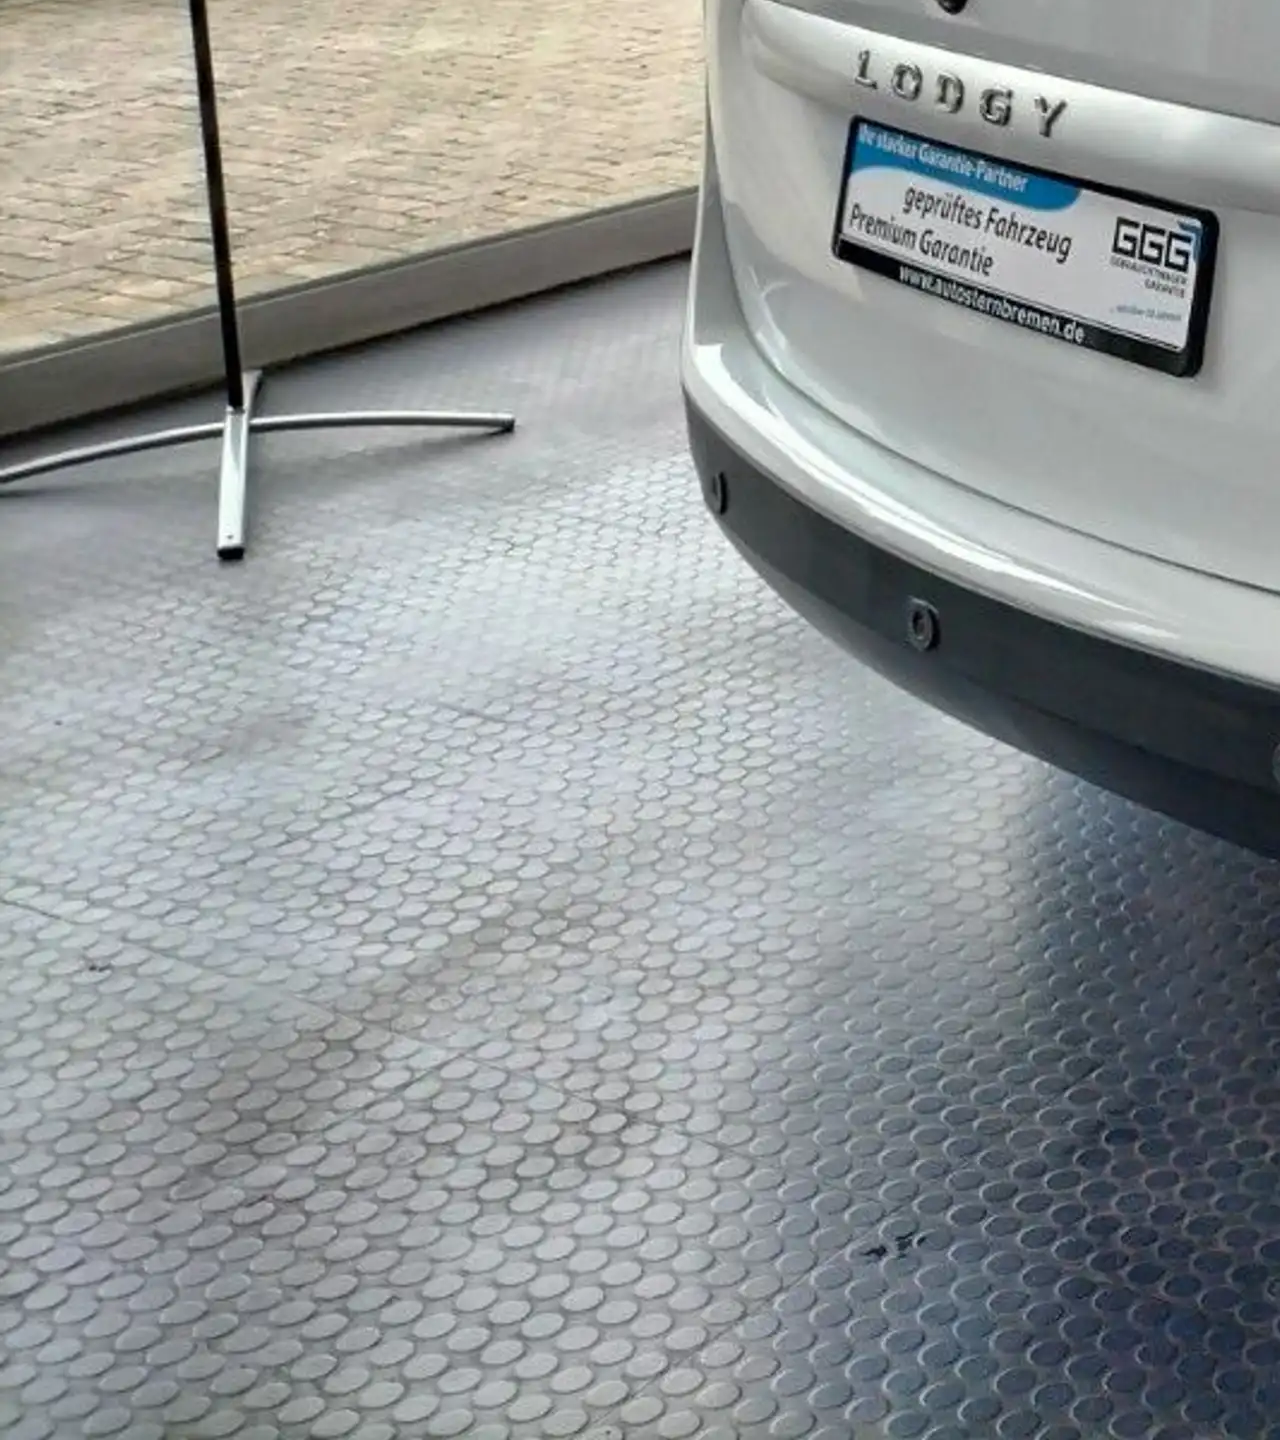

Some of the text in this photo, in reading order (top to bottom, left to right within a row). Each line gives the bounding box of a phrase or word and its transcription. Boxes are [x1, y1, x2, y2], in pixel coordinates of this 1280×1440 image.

[854, 49, 1069, 138] LODGY
[919, 143, 1028, 193] Garantie-Partner
[850, 202, 994, 276] Premium Garantie
[902, 185, 1073, 264] geprüftes Fahrzeug
[1111, 216, 1193, 273] GGG
[900, 264, 1085, 344] www.autosternbremen.de
